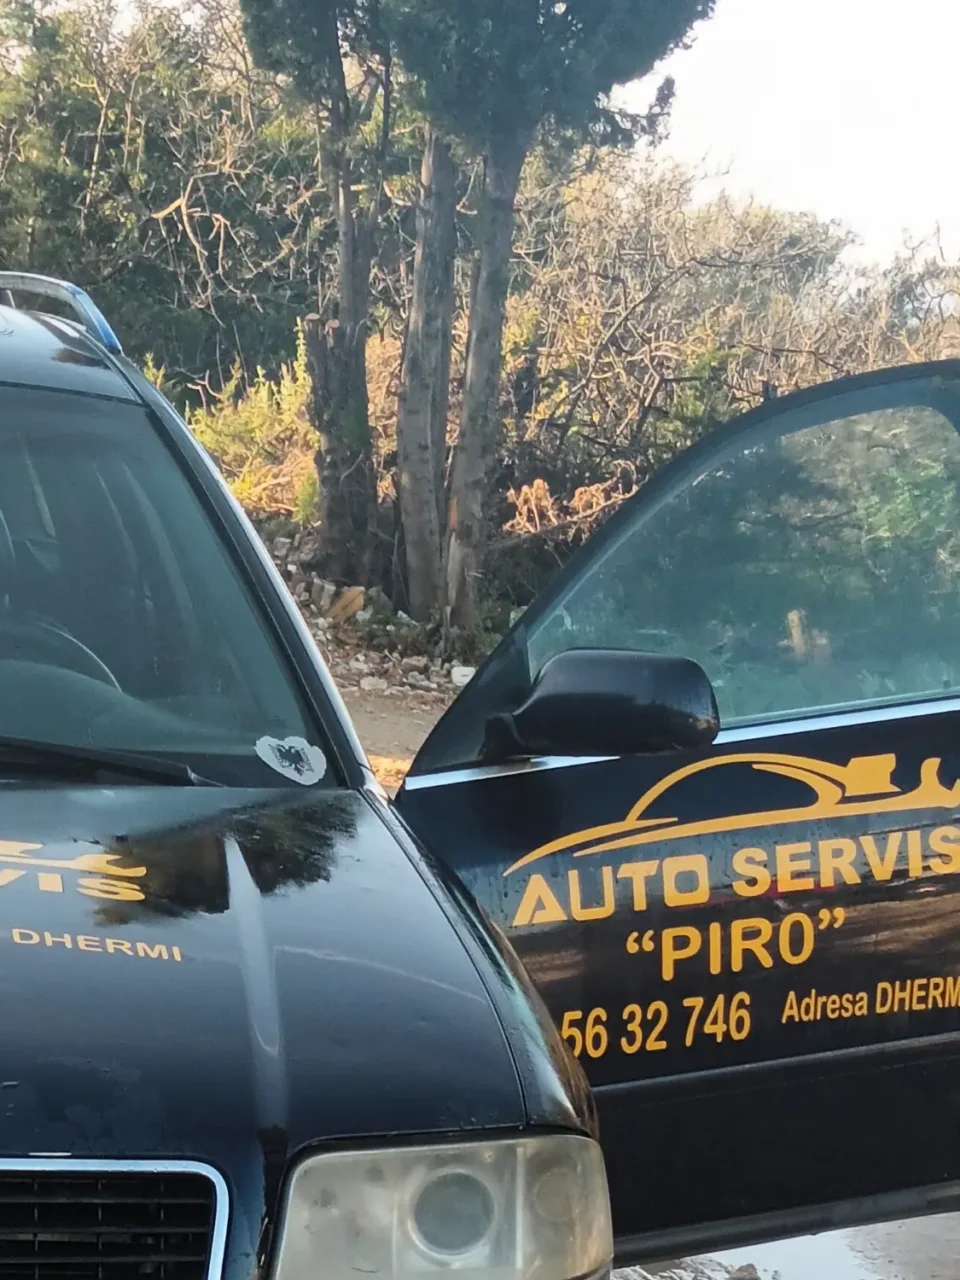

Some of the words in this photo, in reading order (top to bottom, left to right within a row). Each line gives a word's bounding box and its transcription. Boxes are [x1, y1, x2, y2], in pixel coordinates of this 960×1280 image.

[512, 854, 710, 927] AUTO
[731, 825, 960, 898] SERVIS
[12, 928, 182, 962] DHERMI
[626, 907, 845, 981] “PIRO”
[561, 1007, 608, 1059] 56
[621, 1000, 668, 1054] 32
[682, 991, 751, 1047] 746
[781, 990, 868, 1024] Adresa
